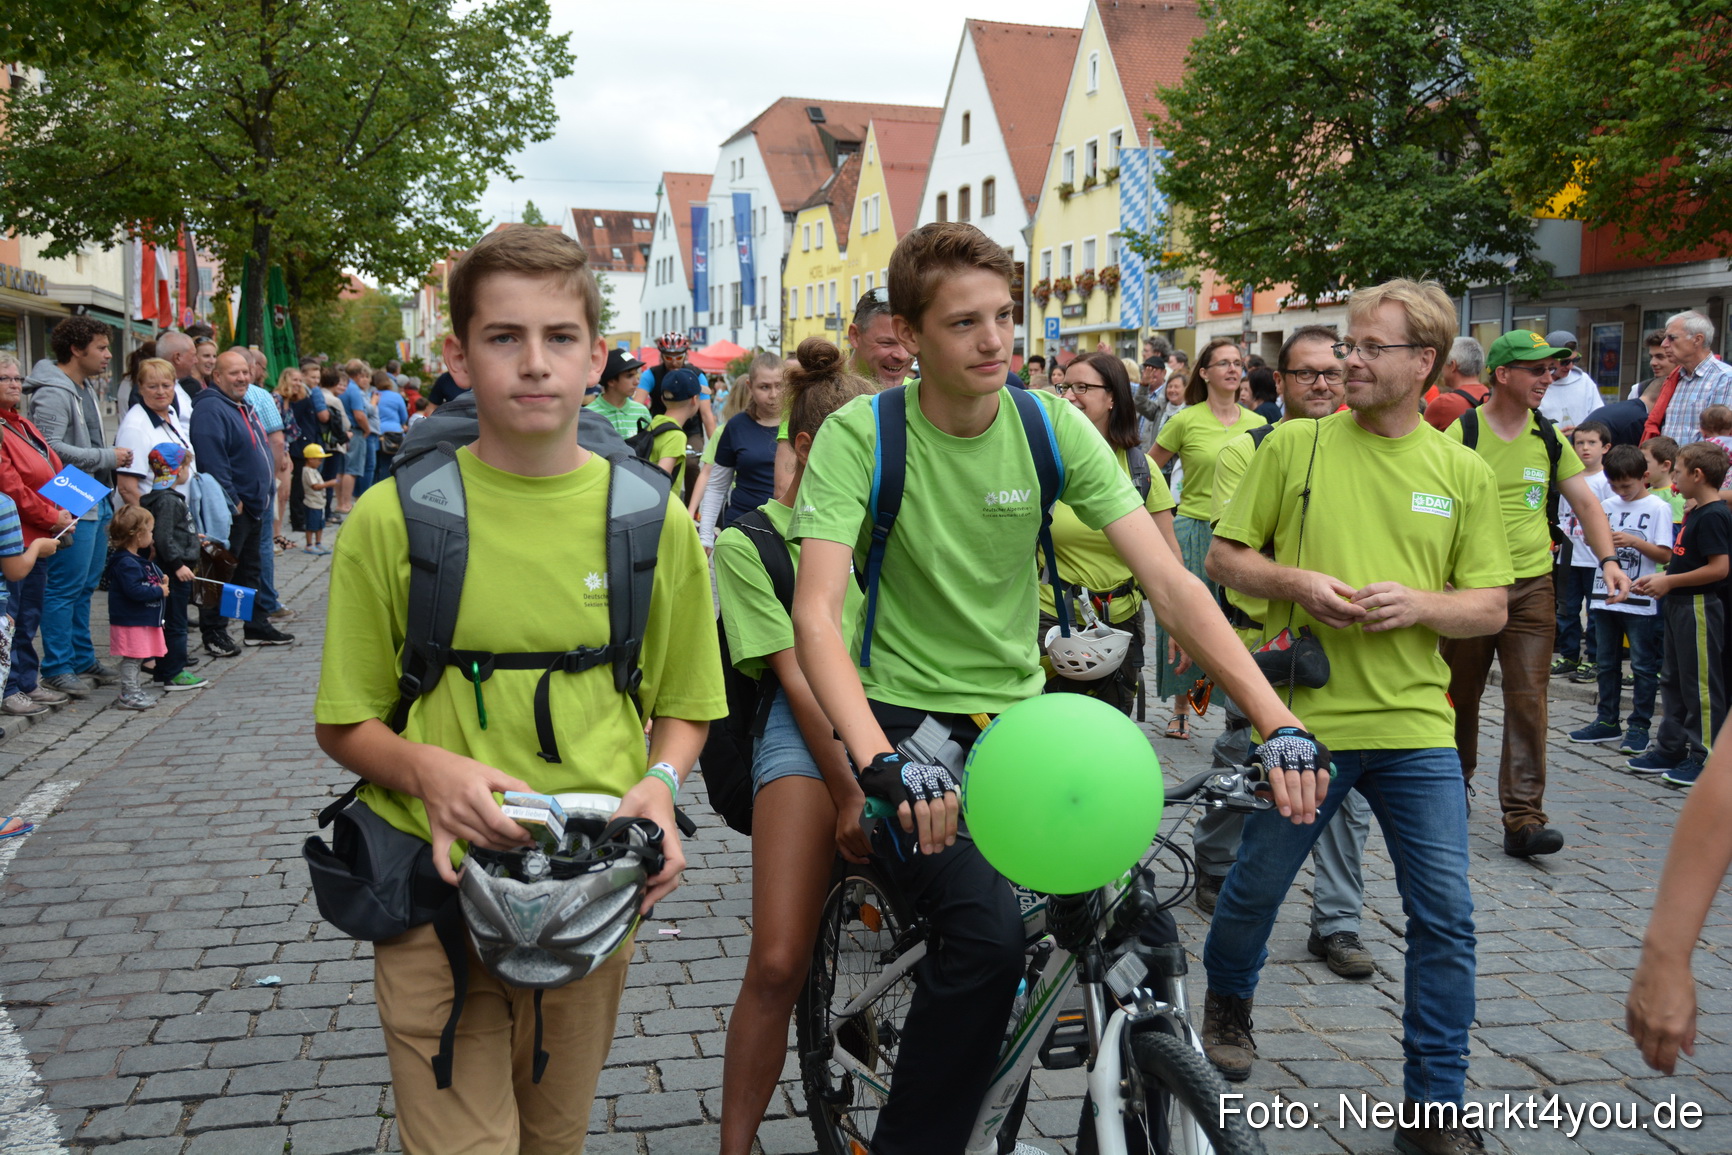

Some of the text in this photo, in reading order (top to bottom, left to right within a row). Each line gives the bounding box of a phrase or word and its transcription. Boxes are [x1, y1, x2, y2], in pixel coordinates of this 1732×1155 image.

[1048, 319, 1057, 335] P
[999, 489, 1031, 504] DAV
[1425, 496, 1449, 509] DAV
